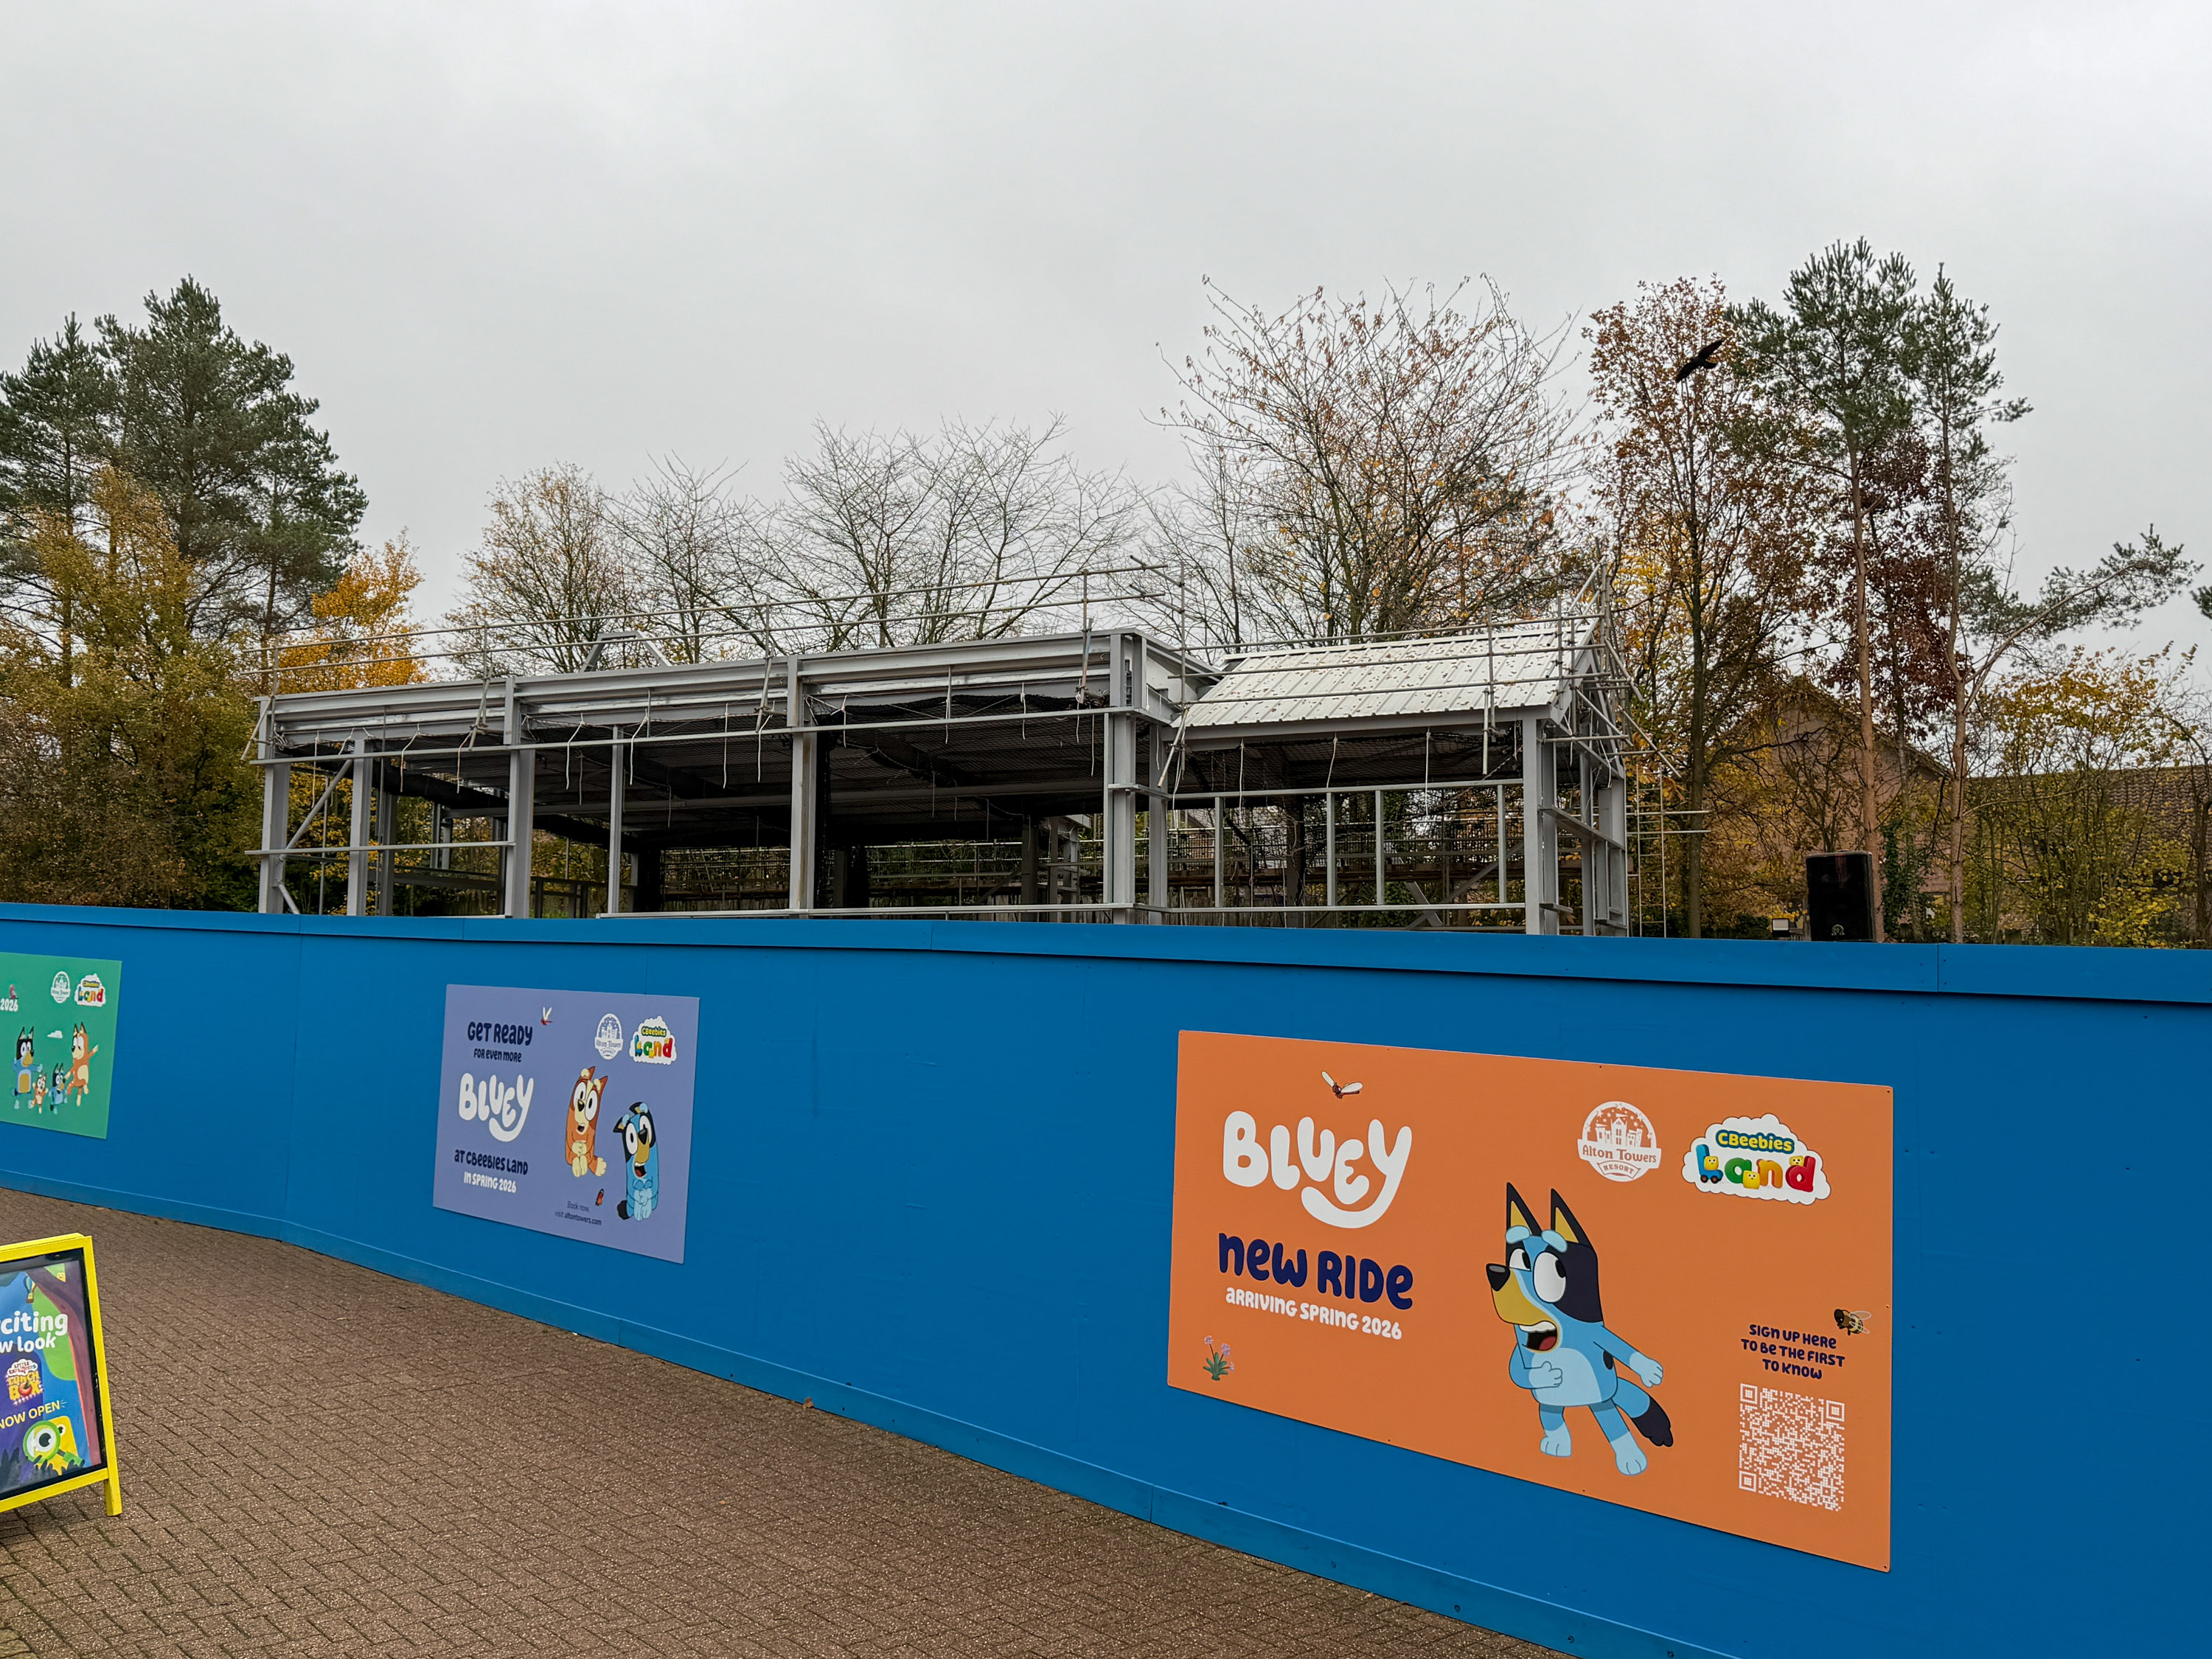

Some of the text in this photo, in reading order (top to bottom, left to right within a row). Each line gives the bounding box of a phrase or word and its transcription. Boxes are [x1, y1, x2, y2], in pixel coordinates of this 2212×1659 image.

[0, 998, 18, 1012] 2026
[473, 1048, 485, 1059] FOR
[459, 1073, 534, 1141] BLUEY
[1718, 1133, 1793, 1152] CBeebies
[1582, 1144, 1657, 1163] Alton Towers
[1222, 1110, 1412, 1228] BLUEY
[1603, 1164, 1635, 1175] RESORT
[1696, 1144, 1816, 1192] Land
[498, 1178, 517, 1193] 2026
[0, 1310, 68, 1336] citing
[1361, 1315, 1402, 1340] 2026
[17, 1332, 57, 1353] look
[1782, 1329, 1800, 1342] UP
[1741, 1338, 1758, 1352] TO
[1807, 1351, 1846, 1367] FIRST
[1762, 1359, 1779, 1371] TO
[8, 1371, 40, 1385] LUNCH
[0, 1399, 60, 1429] NOW OPEN
